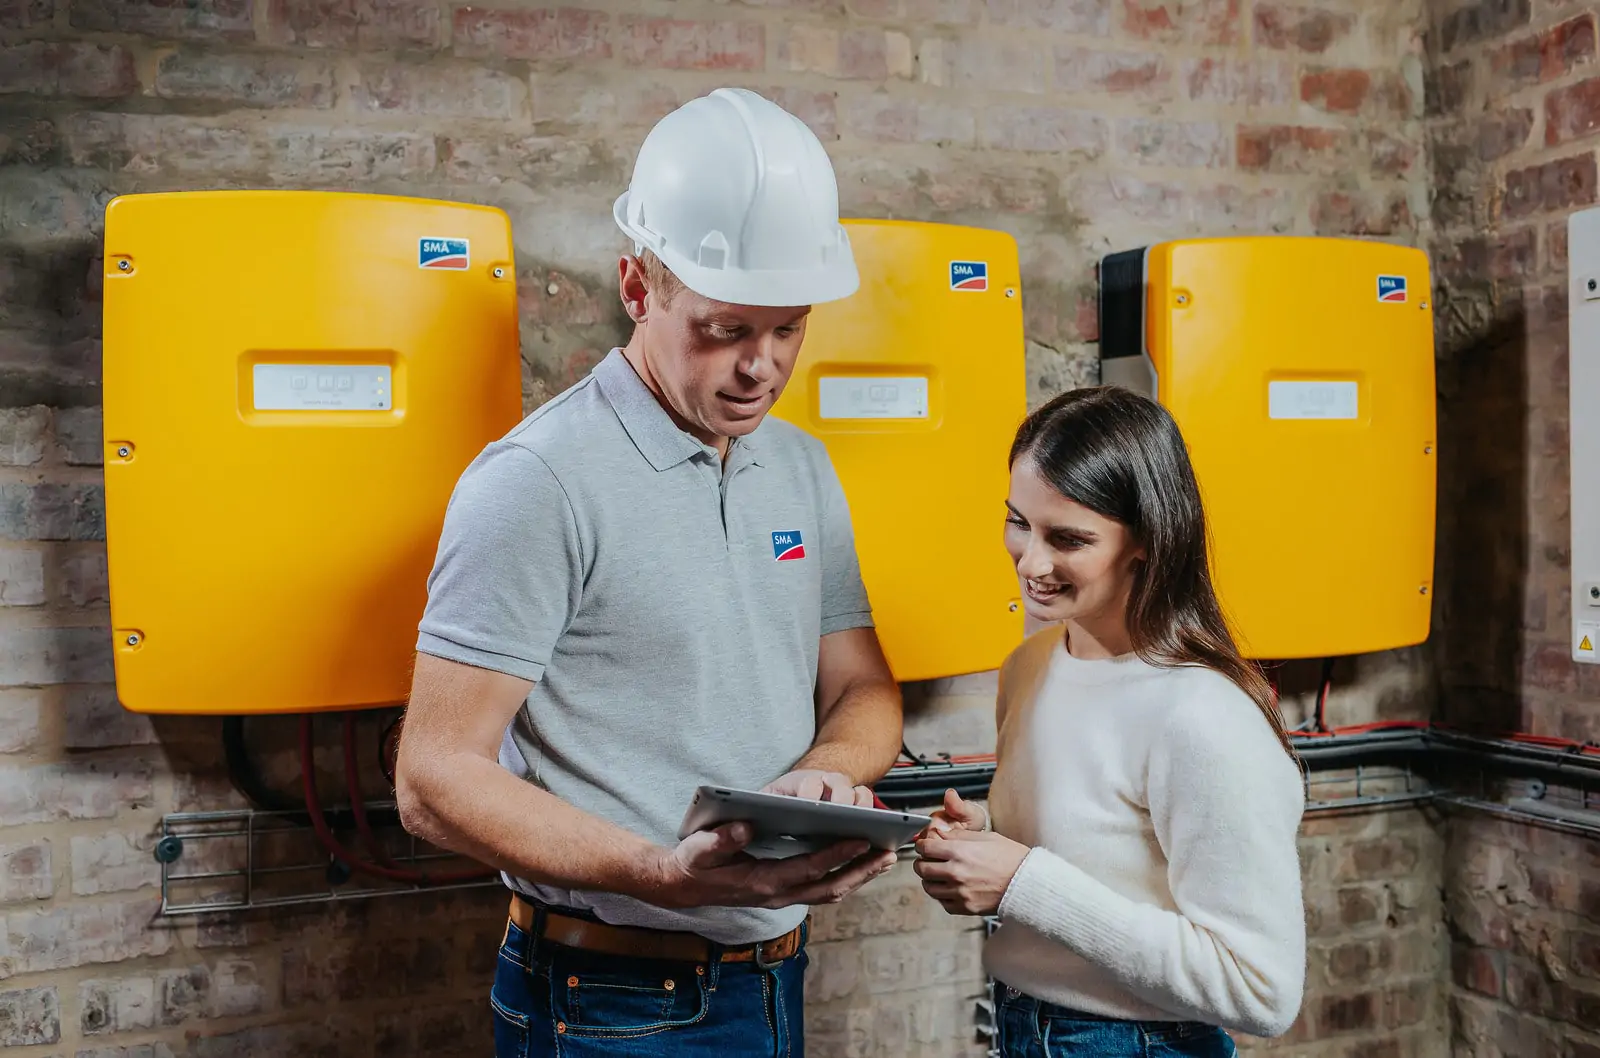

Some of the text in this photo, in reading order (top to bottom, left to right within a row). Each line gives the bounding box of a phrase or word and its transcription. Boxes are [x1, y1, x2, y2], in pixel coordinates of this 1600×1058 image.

[423, 241, 450, 253] SMA
[953, 265, 974, 275] SMA
[774, 535, 793, 545] SMA
